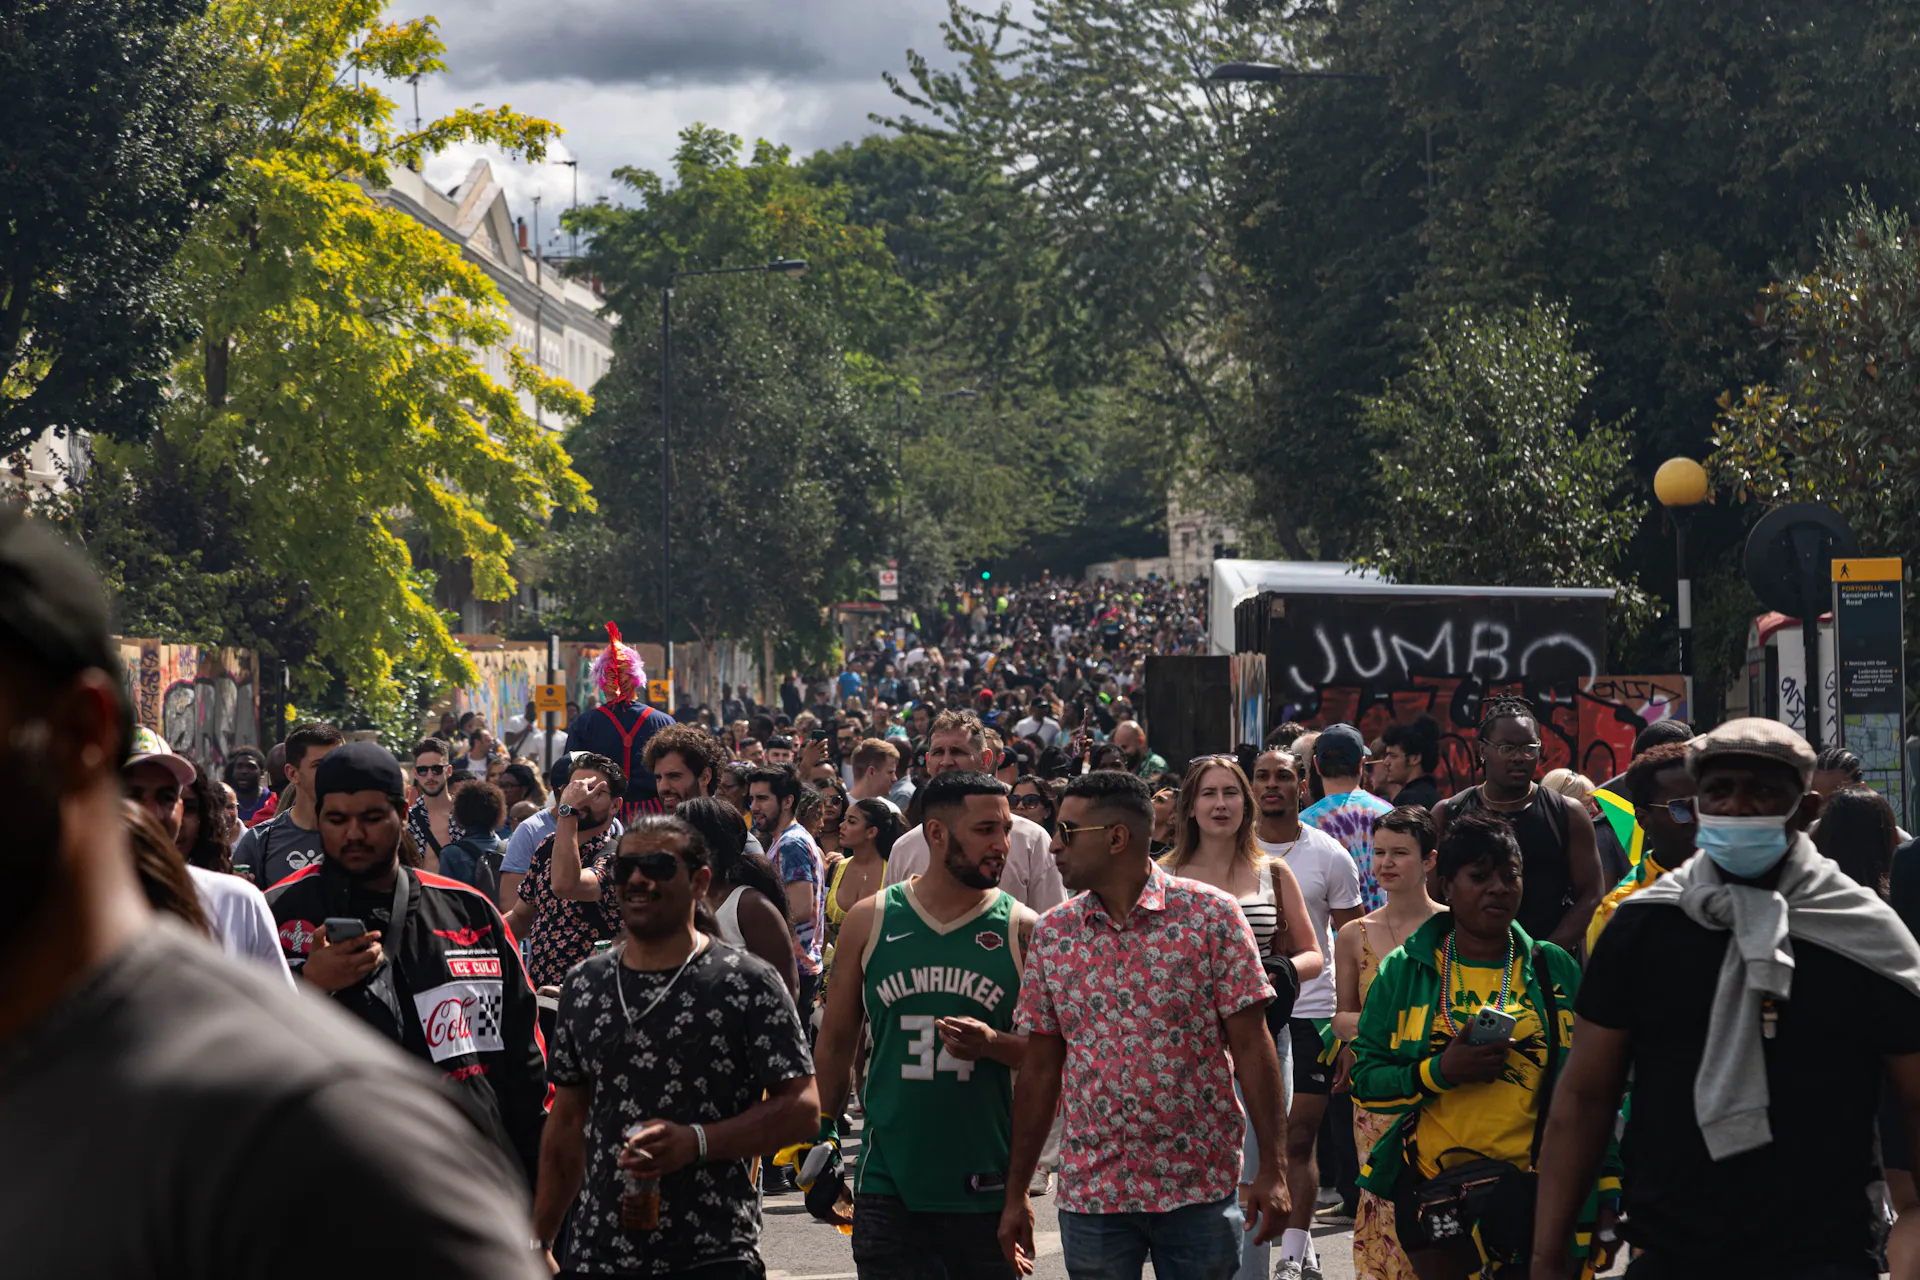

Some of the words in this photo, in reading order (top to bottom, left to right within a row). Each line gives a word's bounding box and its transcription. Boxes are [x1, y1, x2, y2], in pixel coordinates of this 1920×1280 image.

[1841, 592, 1878, 600] Kensington
[1288, 620, 1597, 693] JUMBO
[453, 962, 470, 973] ICE
[472, 961, 498, 973] COLD
[876, 966, 1005, 1012] MILWAUKEE
